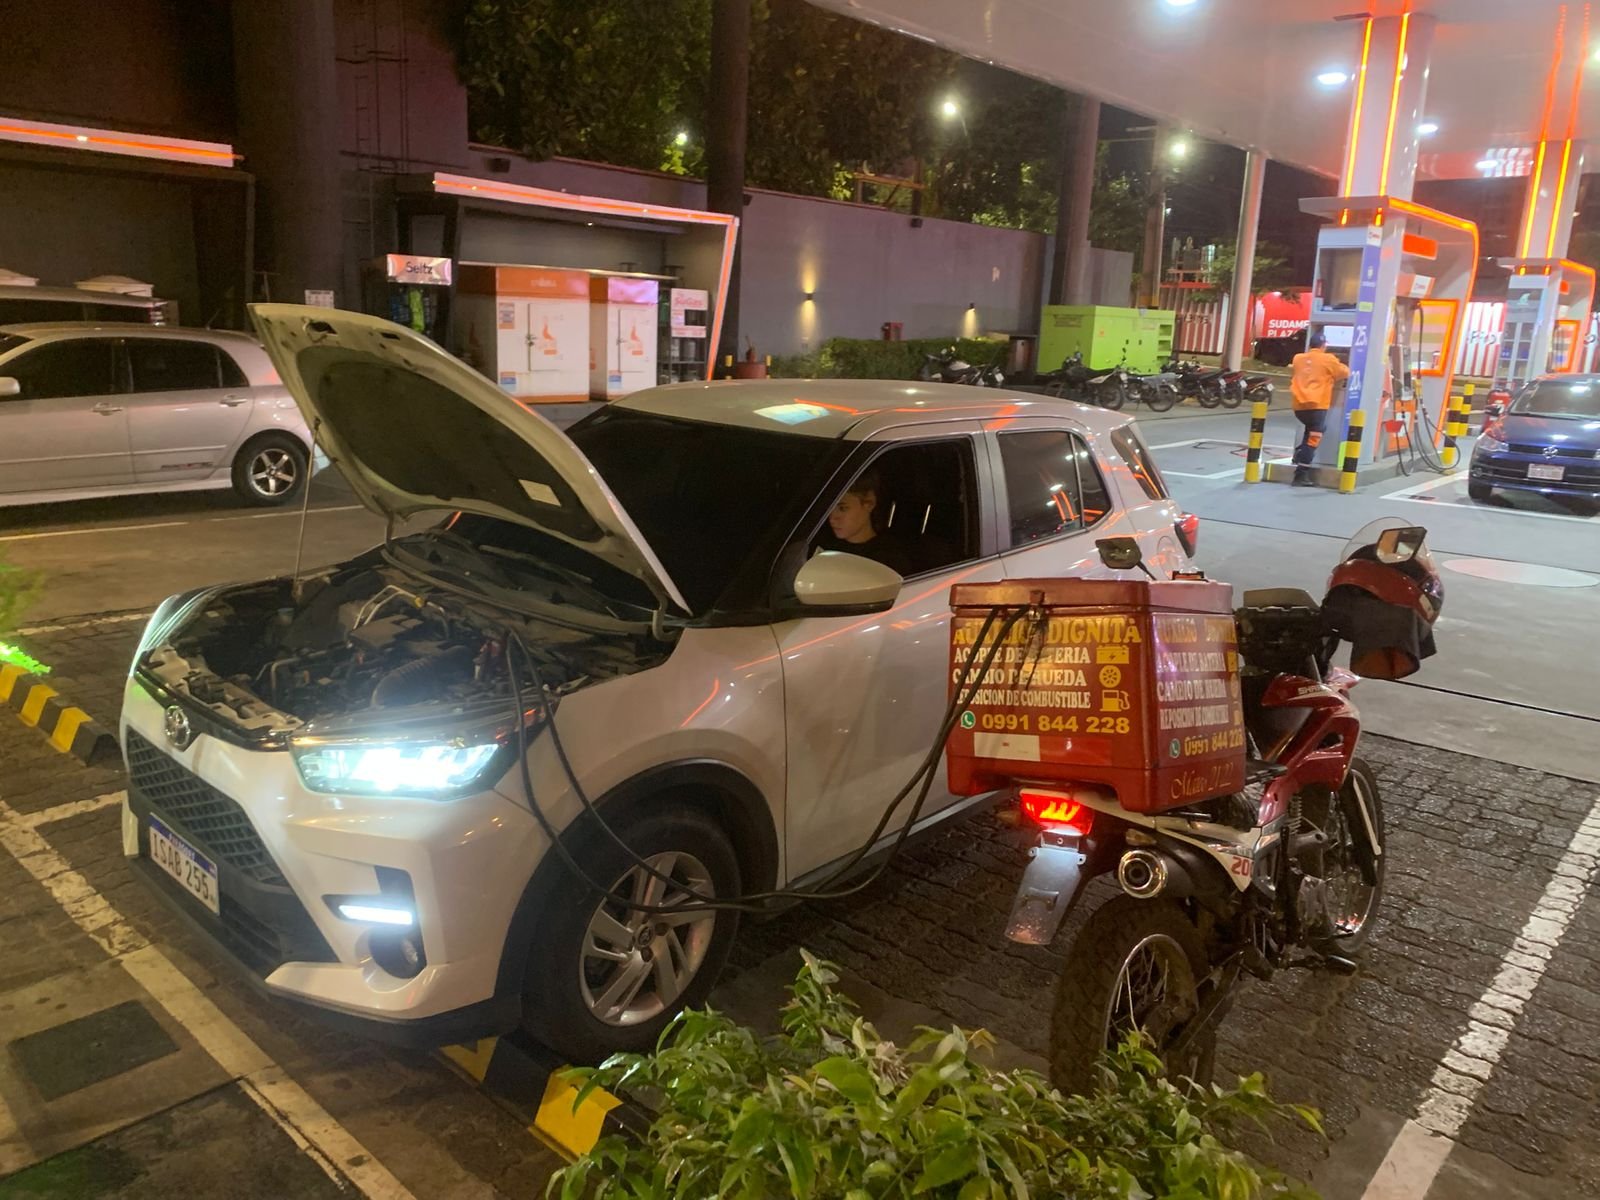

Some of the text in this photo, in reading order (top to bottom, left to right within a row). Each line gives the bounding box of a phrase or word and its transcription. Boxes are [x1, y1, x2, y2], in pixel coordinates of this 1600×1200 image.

[406, 261, 433, 275] Seltz
[1267, 329, 1298, 338] PLAZ
[954, 647, 1003, 664] ACPE
[1006, 690, 1019, 706] DE
[1020, 690, 1091, 709] COMBUSTIBLE
[982, 713, 1130, 734] 0991 844 228
[1184, 736, 1209, 756] 0991
[185, 860, 209, 900] 255
